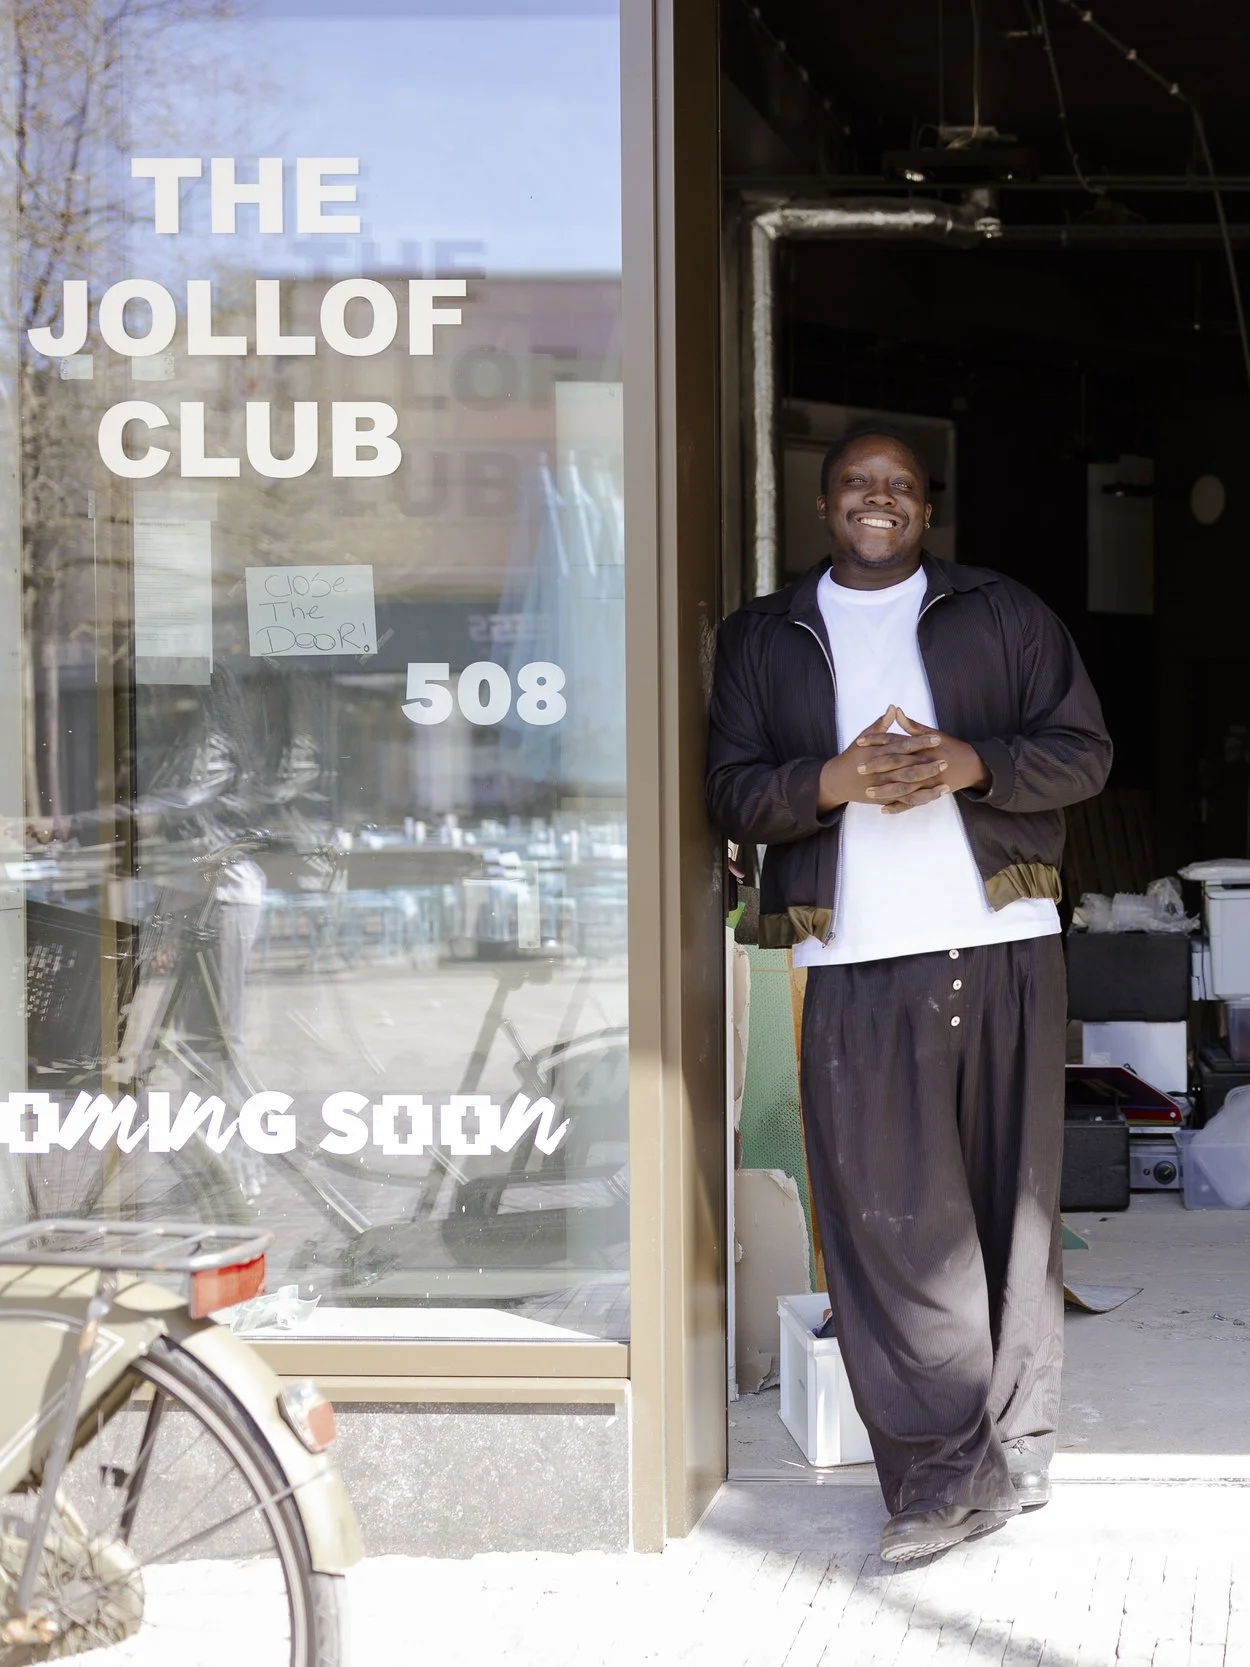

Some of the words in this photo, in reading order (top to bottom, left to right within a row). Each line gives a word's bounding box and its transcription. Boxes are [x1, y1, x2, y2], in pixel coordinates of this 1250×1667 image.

[131, 157, 361, 234] THE
[27, 278, 467, 356] JOLLOF
[98, 400, 402, 478] CLUB
[258, 601, 324, 622] The
[401, 661, 567, 726] 508
